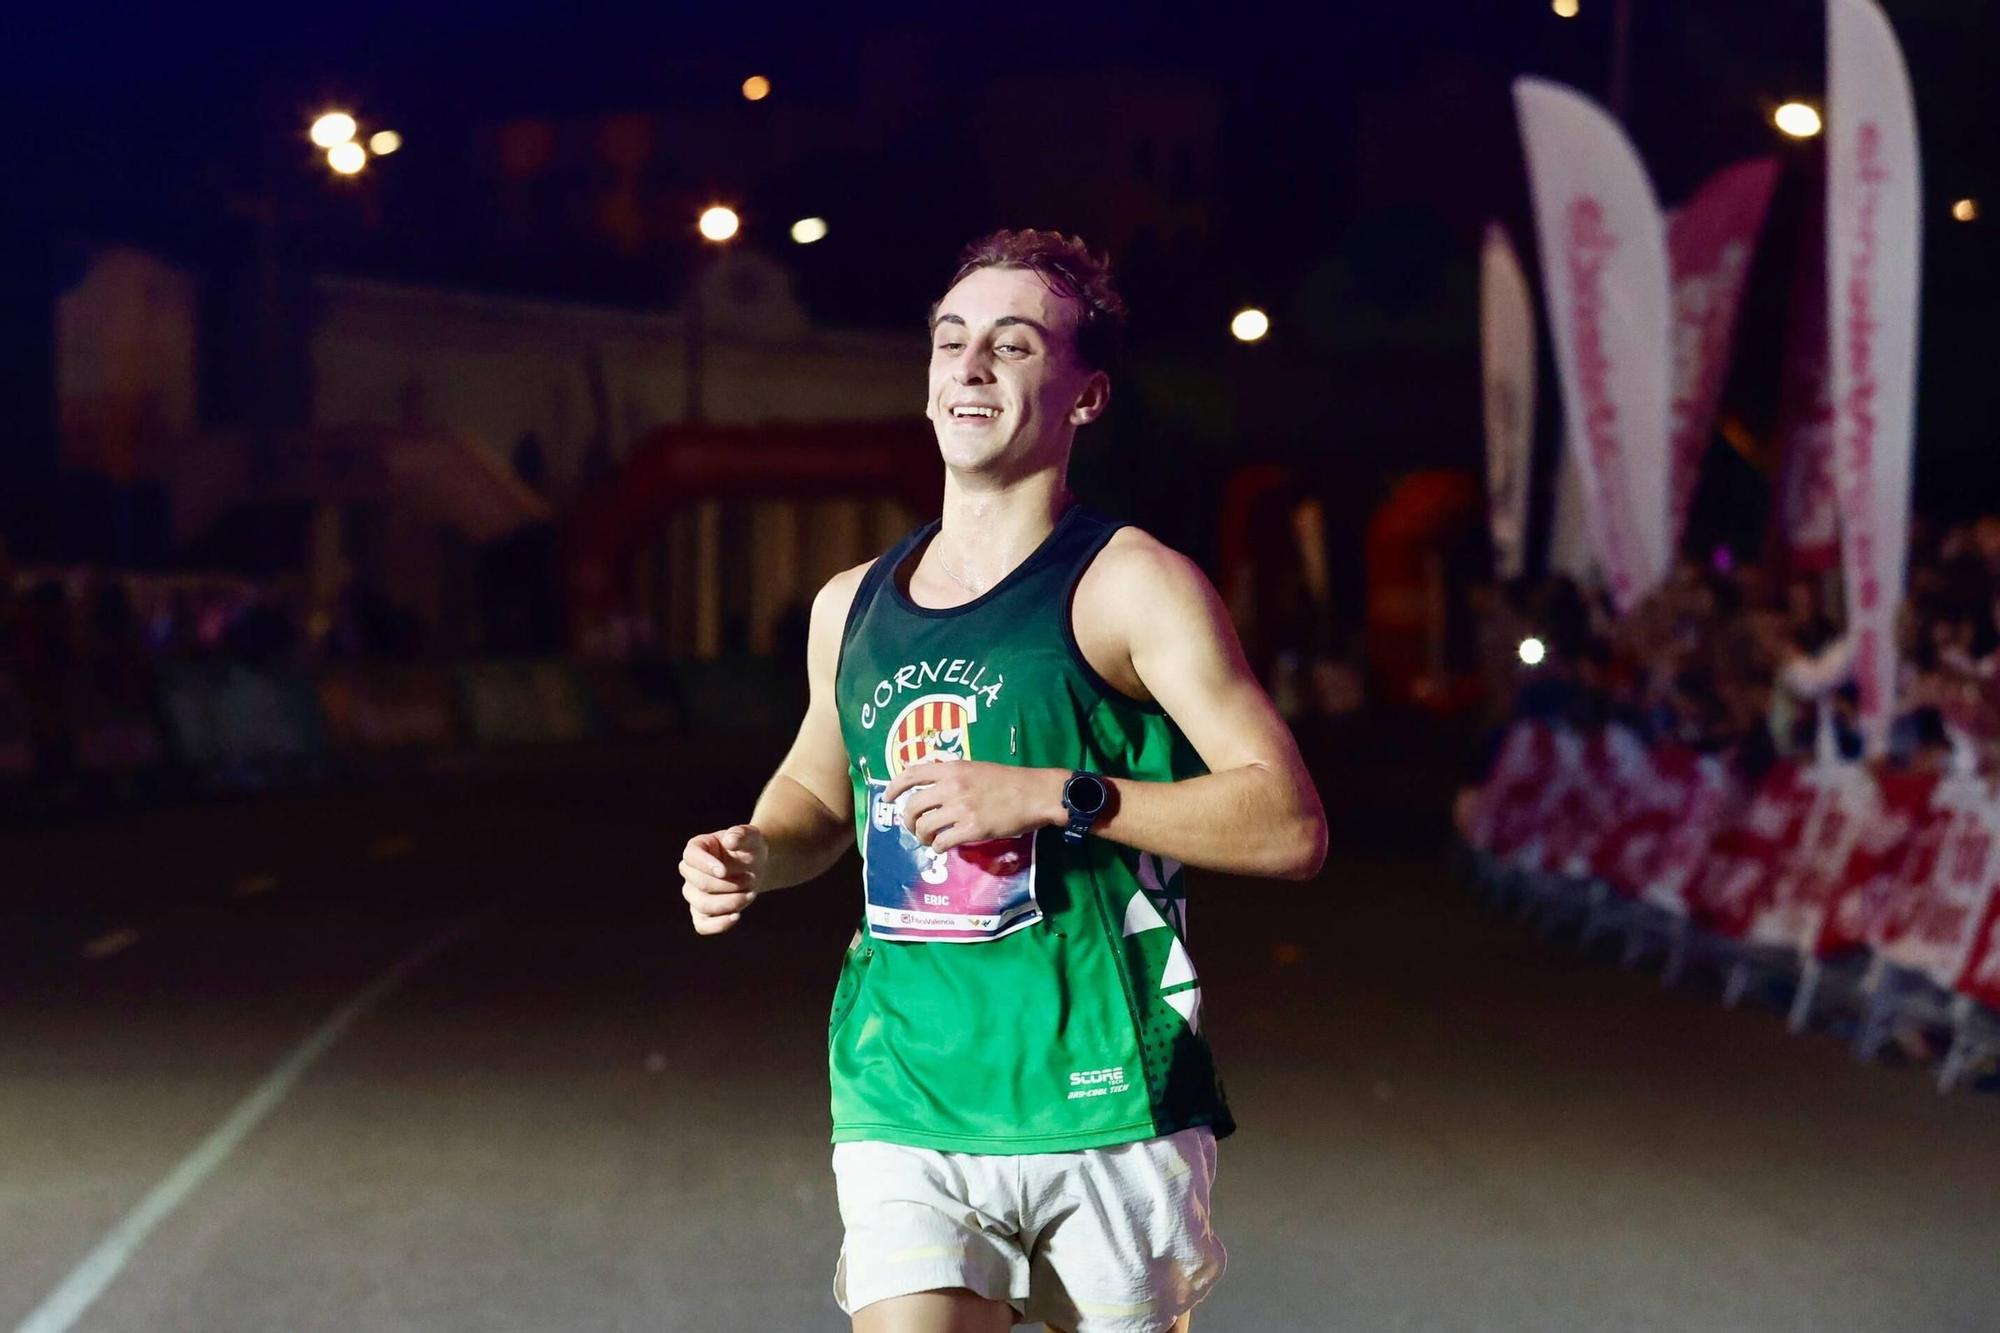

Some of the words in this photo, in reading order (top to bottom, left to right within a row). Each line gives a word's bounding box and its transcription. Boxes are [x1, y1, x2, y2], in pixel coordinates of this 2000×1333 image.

[861, 658, 1004, 729] CORNELLÀ
[923, 893, 950, 906] ERIC
[1069, 1066, 1124, 1086] SCORE
